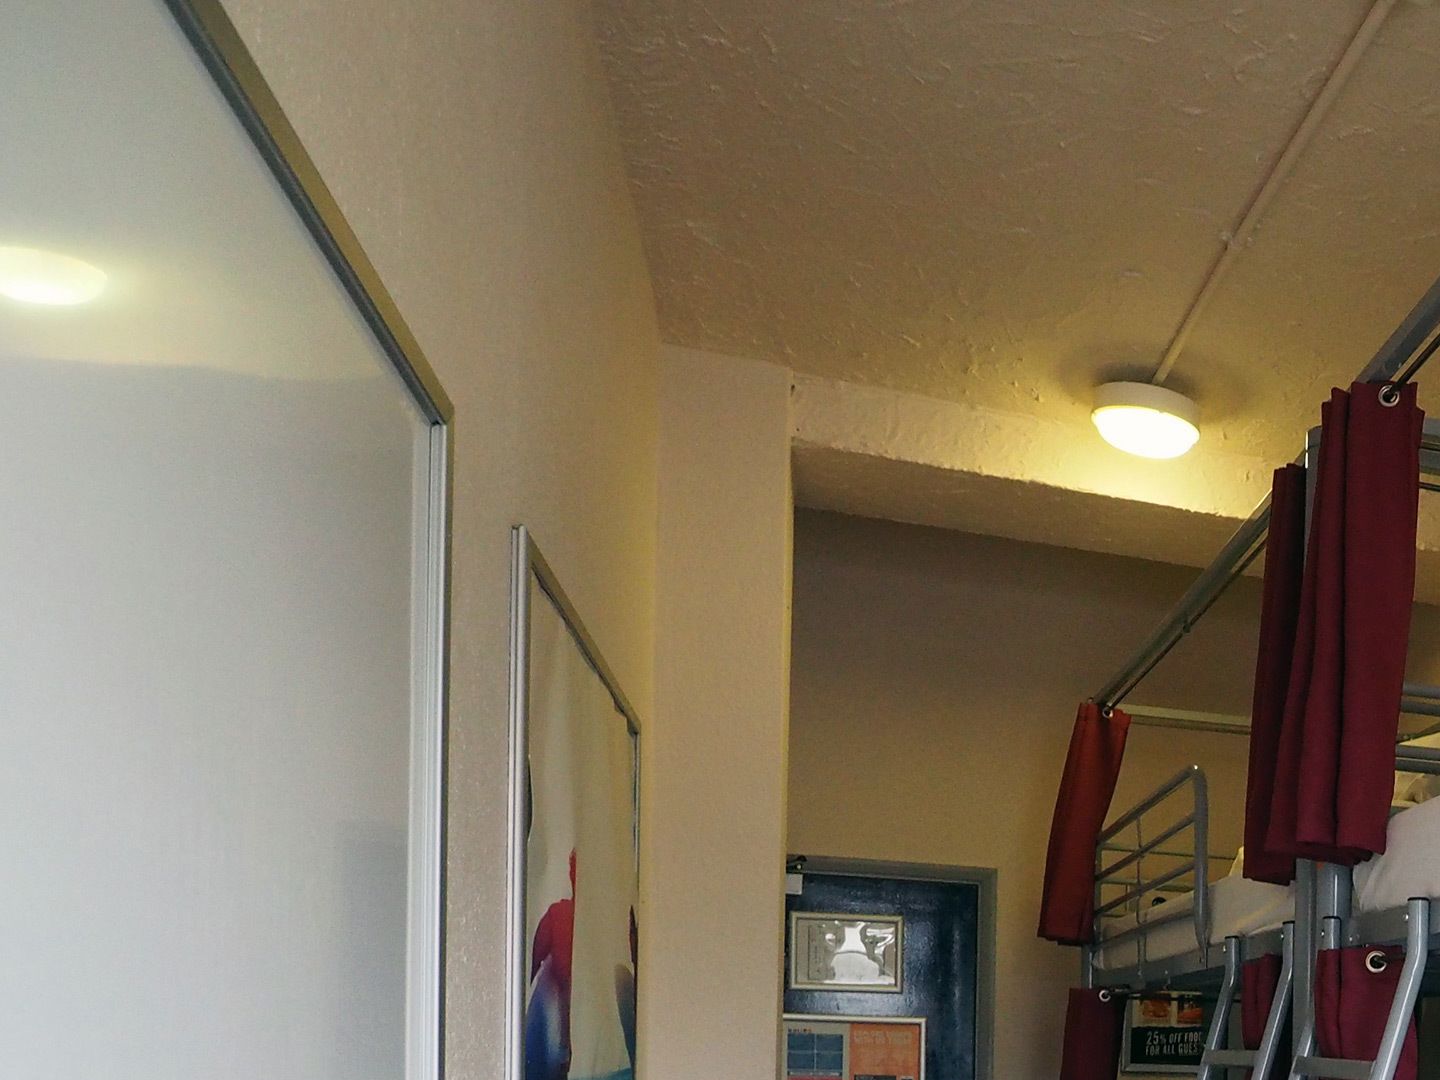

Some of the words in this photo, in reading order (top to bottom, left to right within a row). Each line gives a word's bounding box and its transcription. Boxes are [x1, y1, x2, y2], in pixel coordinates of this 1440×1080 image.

[1146, 1031, 1167, 1044] 25%
[1169, 1032, 1183, 1044] OFF
[1145, 1044, 1160, 1056] FOR
[1162, 1044, 1175, 1055] ALL
